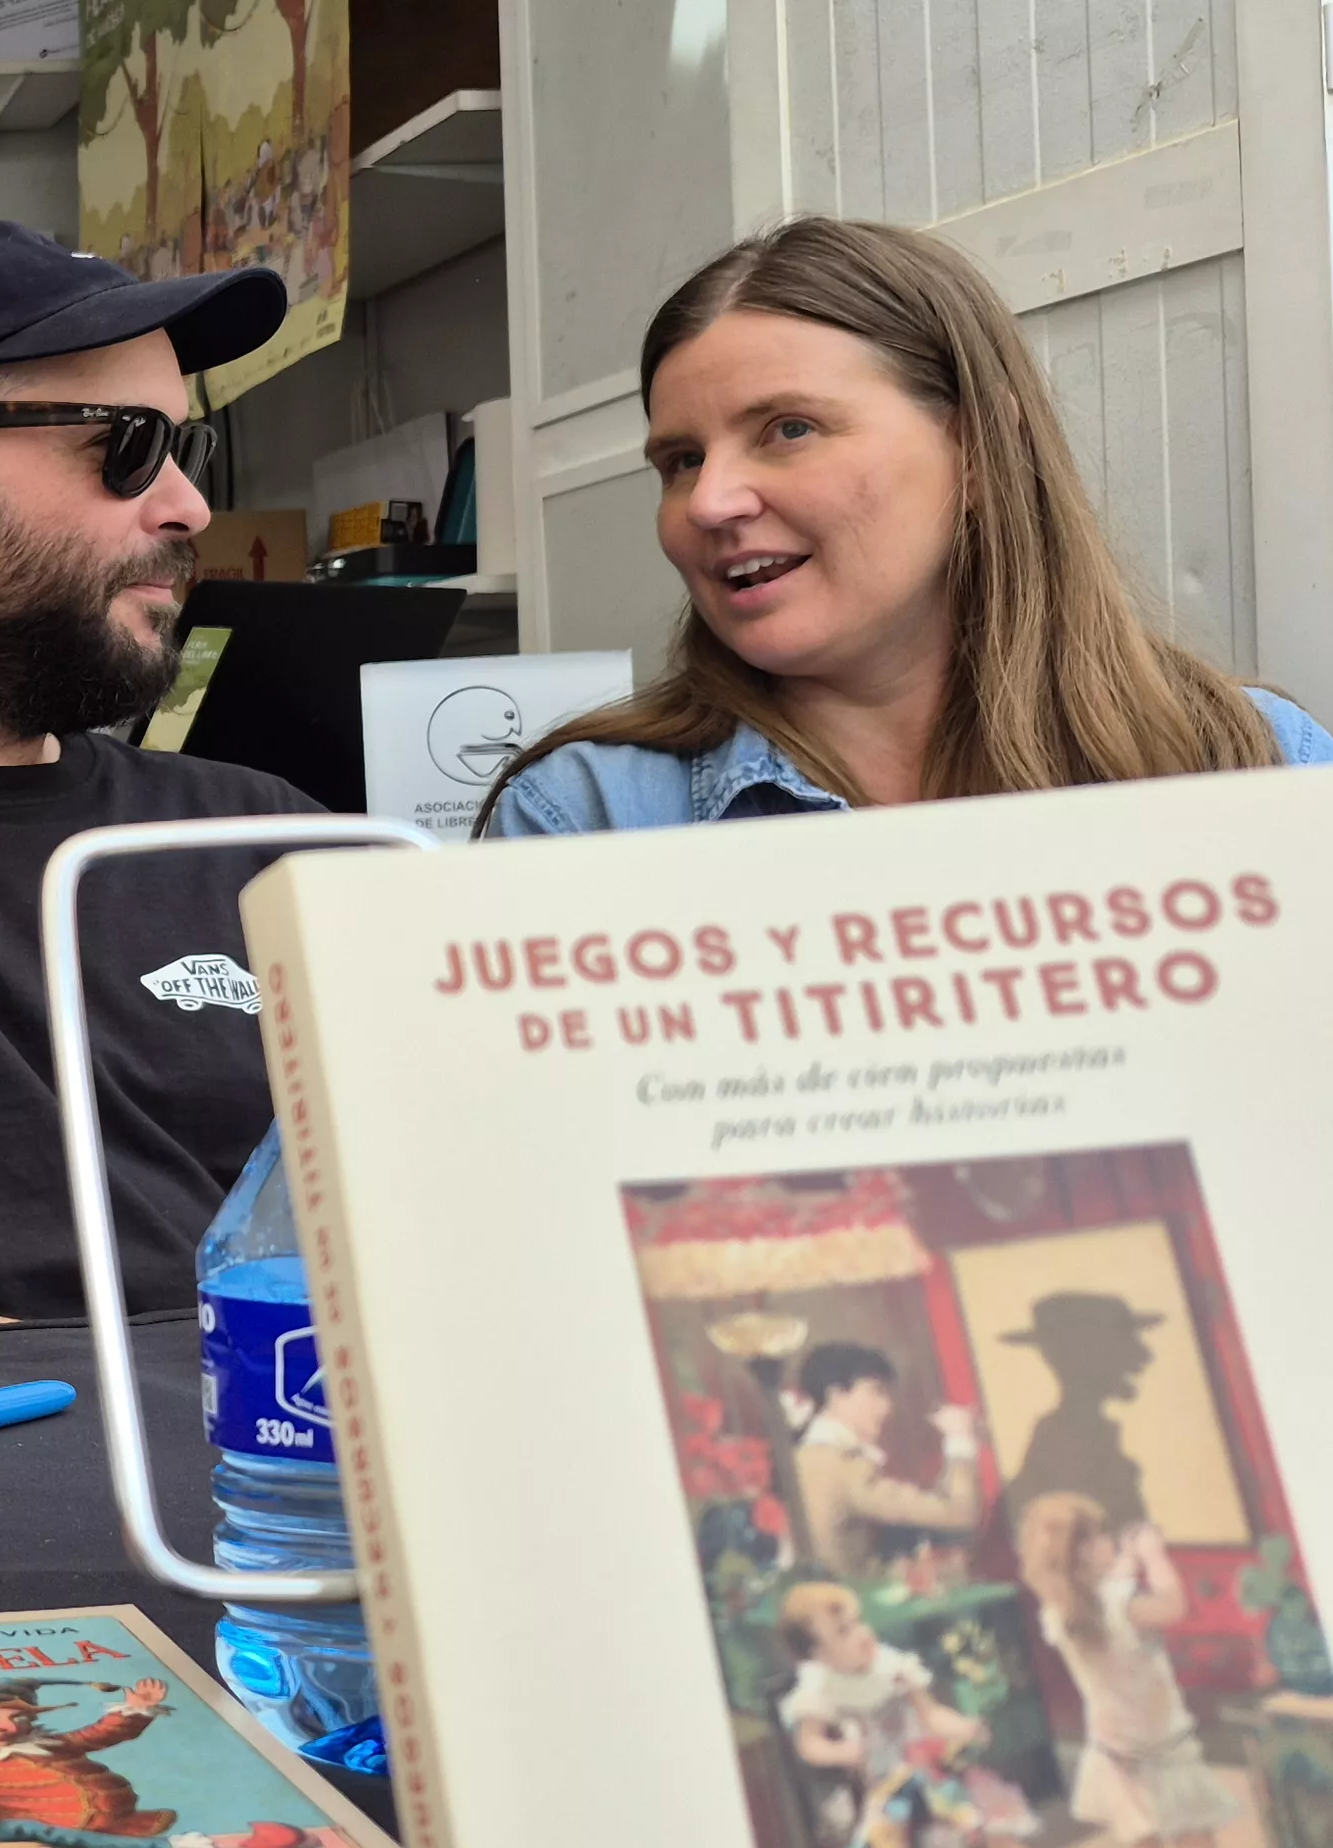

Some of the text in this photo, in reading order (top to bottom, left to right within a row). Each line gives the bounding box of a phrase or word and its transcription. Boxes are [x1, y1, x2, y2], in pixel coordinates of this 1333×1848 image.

[433, 871, 1282, 996] JUEGOS Y RECURSOS
[181, 961, 229, 976] VANS
[194, 977, 229, 999] THE
[518, 950, 1220, 1052] DE UN TITIRITERO
[637, 1073, 706, 1105] Con
[796, 1060, 838, 1092] de
[847, 1064, 917, 1089] cien
[927, 1046, 1126, 1090] propuestas
[710, 1095, 1066, 1152] para crear historias
[0, 1626, 80, 1638] VIDA
